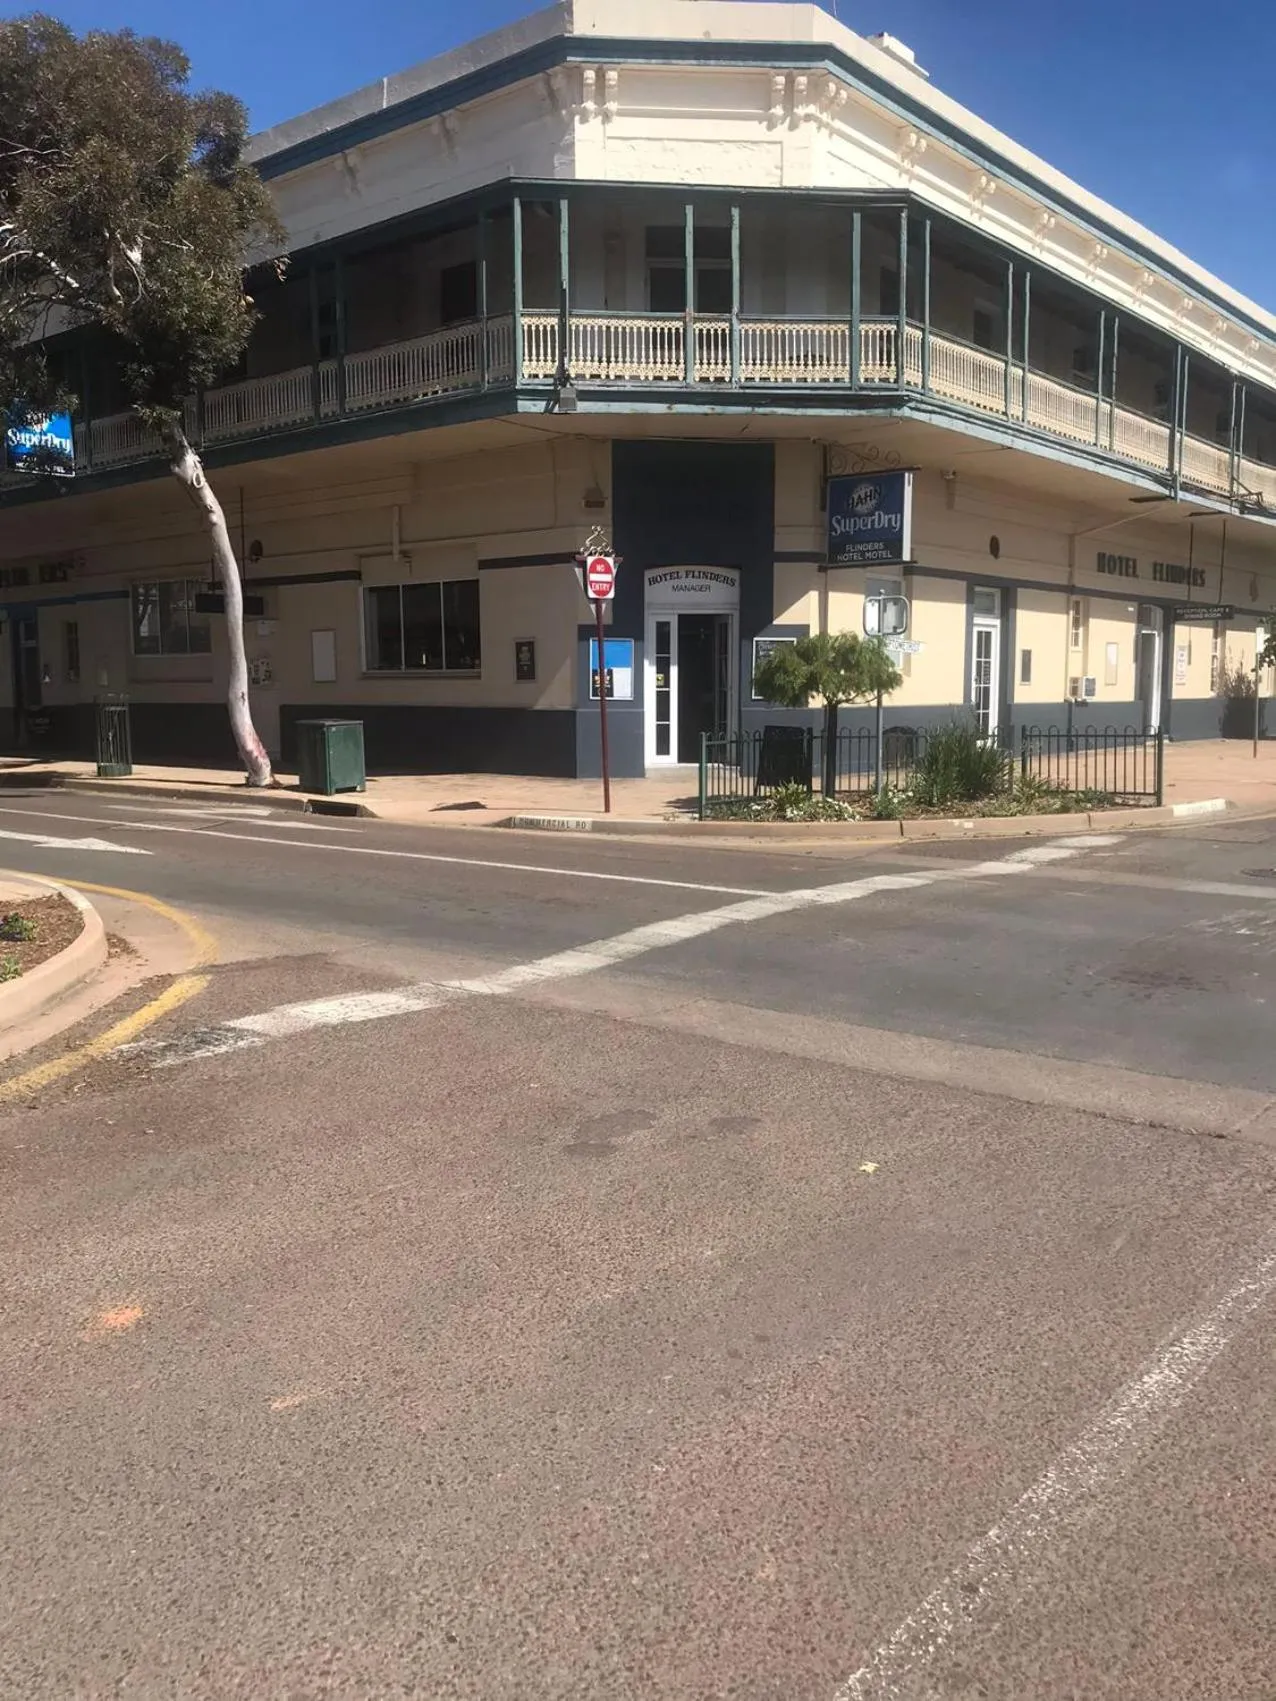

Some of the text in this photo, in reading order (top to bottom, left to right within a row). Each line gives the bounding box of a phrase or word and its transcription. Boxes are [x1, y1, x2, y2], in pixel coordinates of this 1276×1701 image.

[831, 511, 901, 536] SuperDry
[845, 542, 885, 552] FLINDERS
[837, 550, 893, 561] HOTEL MOTEL
[595, 564, 605, 572] NO
[1096, 551, 1139, 578] HOTEL
[648, 570, 737, 588] HOTEL FLINDERS
[591, 582, 610, 591] ENTRY
[671, 584, 711, 593] MANAGER
